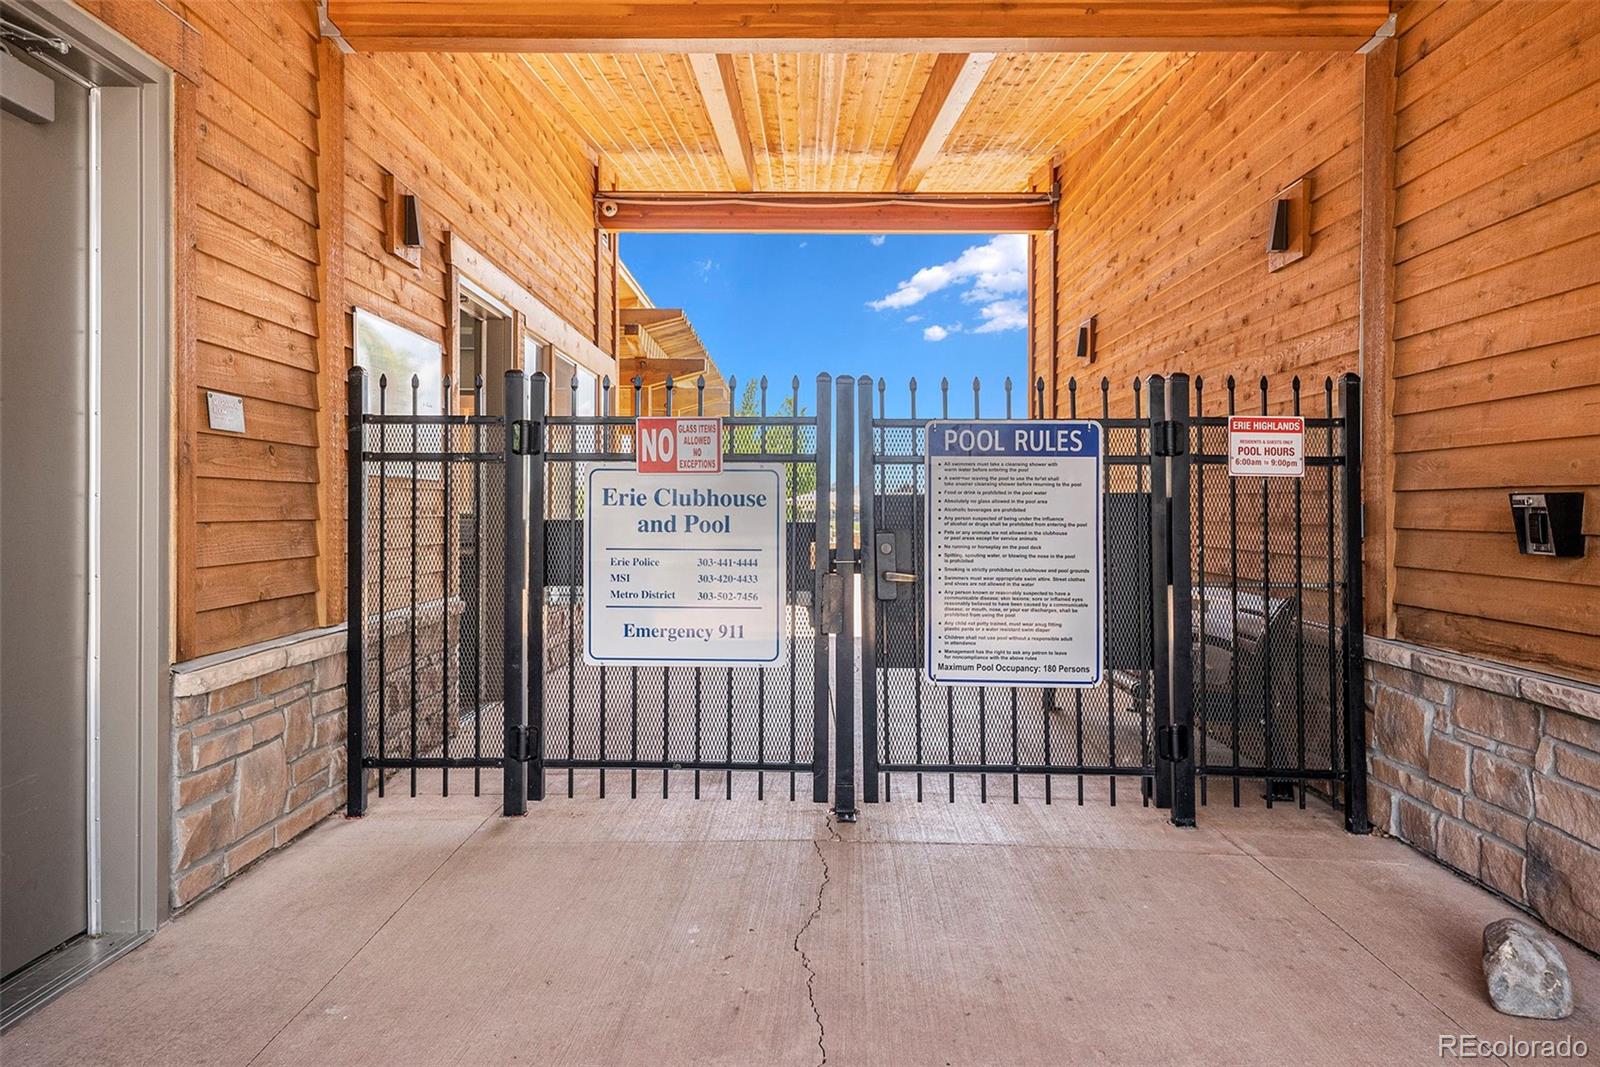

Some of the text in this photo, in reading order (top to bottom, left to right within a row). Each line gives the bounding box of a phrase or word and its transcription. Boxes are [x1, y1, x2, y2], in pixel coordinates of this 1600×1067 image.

[678, 424, 716, 433] GLASS ITEMS
[1254, 422, 1300, 430] HIGHLANDS
[684, 437, 711, 445] ALLOWED
[944, 430, 1082, 451] POOL RULES
[642, 428, 674, 463] NO
[1238, 447, 1295, 456] POOL HOURS
[680, 460, 716, 468] EXCEPTIONS
[1271, 459, 1297, 468] 9:00pm
[602, 488, 767, 507] Erie Clubhouse
[638, 515, 730, 533] and Pool
[610, 558, 659, 567] Erie Police
[697, 558, 758, 567] 303-441-4444
[610, 574, 630, 582] MSI
[698, 574, 758, 584] 303-420-4433
[610, 591, 675, 599] Metro District
[698, 592, 758, 601] 303-502-7456
[624, 624, 744, 642] Emergency 911
[938, 663, 974, 671] Maximum
[977, 664, 994, 672] Pool
[996, 664, 1041, 673] Occupancy:
[1059, 665, 1090, 673] Persons
